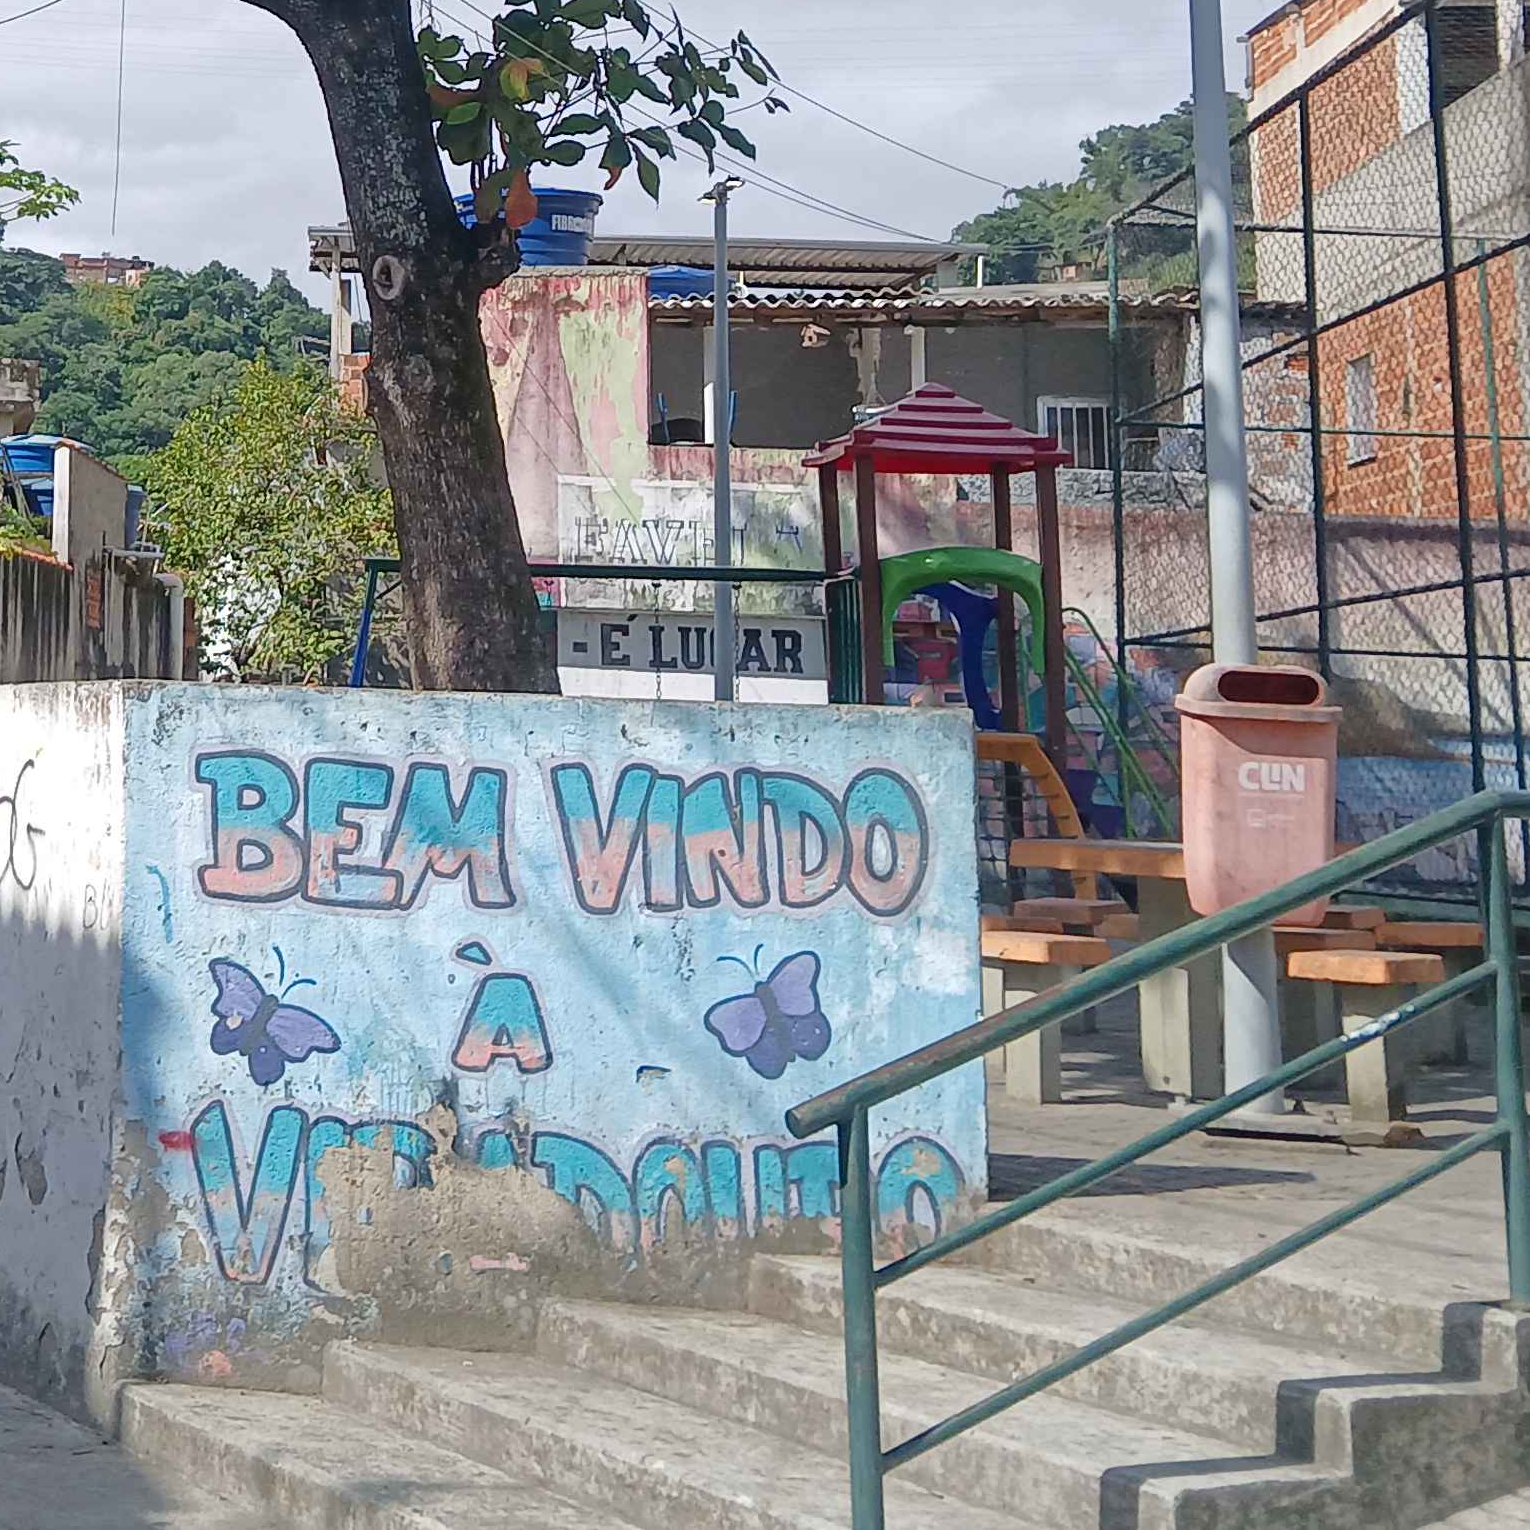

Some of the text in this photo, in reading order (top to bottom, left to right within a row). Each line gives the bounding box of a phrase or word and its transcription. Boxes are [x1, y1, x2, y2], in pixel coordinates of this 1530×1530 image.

[648, 624, 805, 674] LUAR
[1237, 760, 1305, 792] CLIN
[195, 751, 930, 917] BEM VINDO
[451, 941, 554, 1073] À
